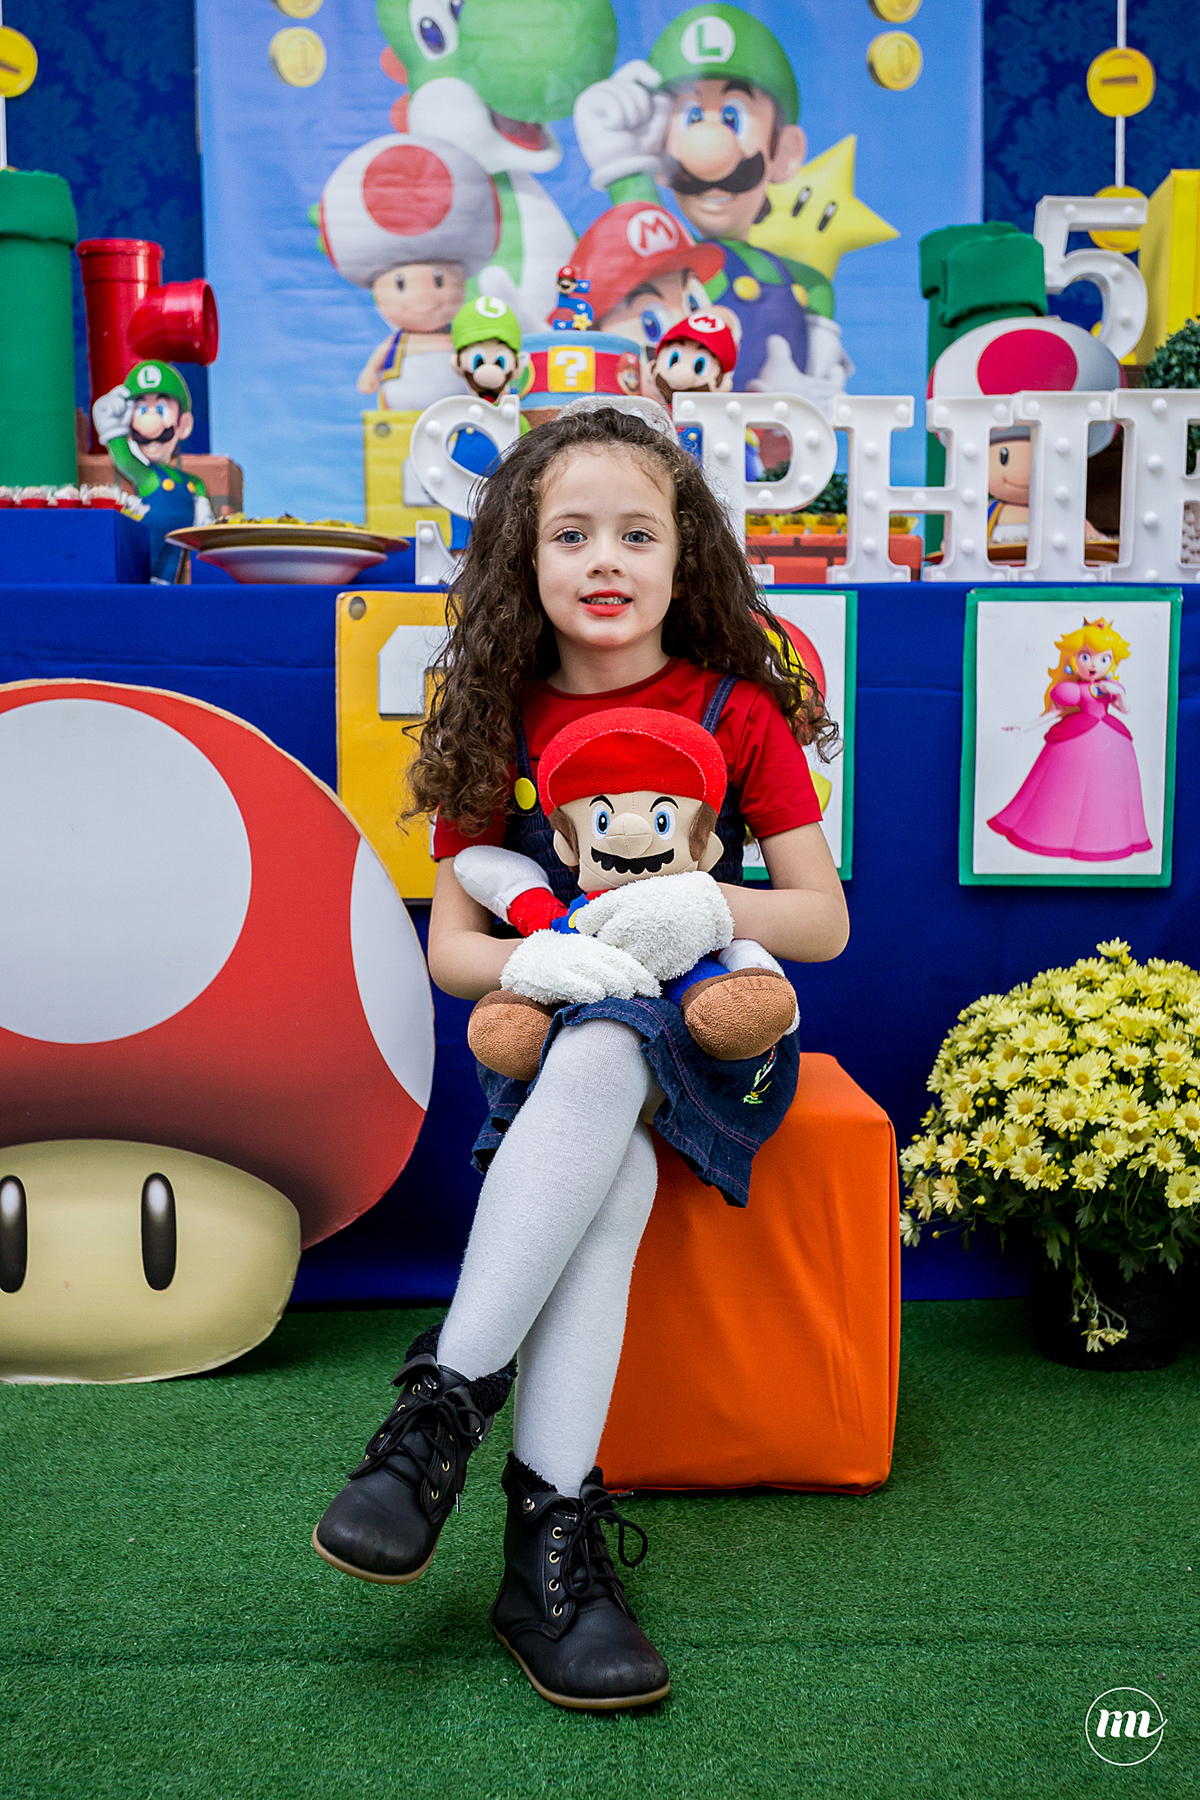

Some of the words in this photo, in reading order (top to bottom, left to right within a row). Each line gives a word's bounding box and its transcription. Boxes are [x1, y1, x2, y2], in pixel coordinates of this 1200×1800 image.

[694, 23, 723, 58] L
[638, 215, 675, 250] M
[1033, 194, 1149, 362] 5
[484, 296, 499, 315] L
[693, 315, 718, 329] M
[143, 370, 155, 384] L
